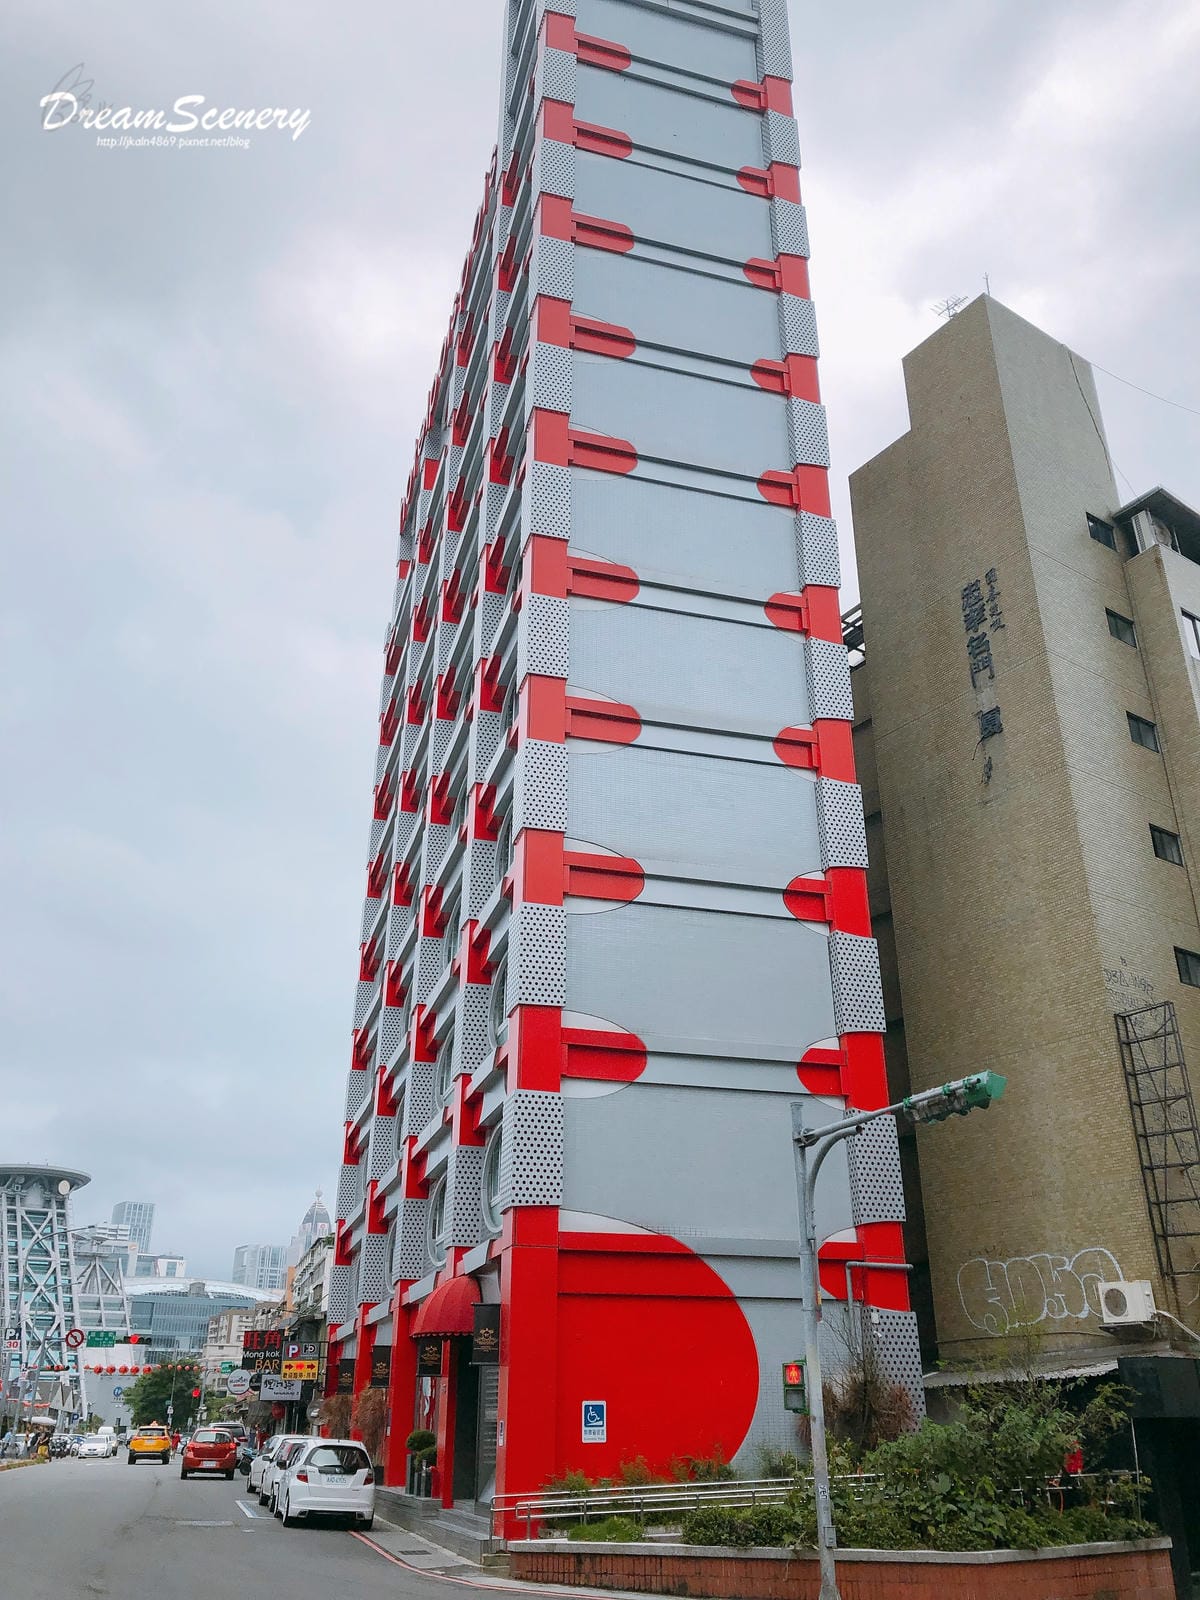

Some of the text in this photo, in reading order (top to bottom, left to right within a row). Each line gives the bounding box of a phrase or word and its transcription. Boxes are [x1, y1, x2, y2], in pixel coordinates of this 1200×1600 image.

[244, 1330, 281, 1350] 旺角
[243, 1351, 264, 1359] Mong
[288, 1345, 299, 1358] P
[255, 1359, 280, 1370] BAR
